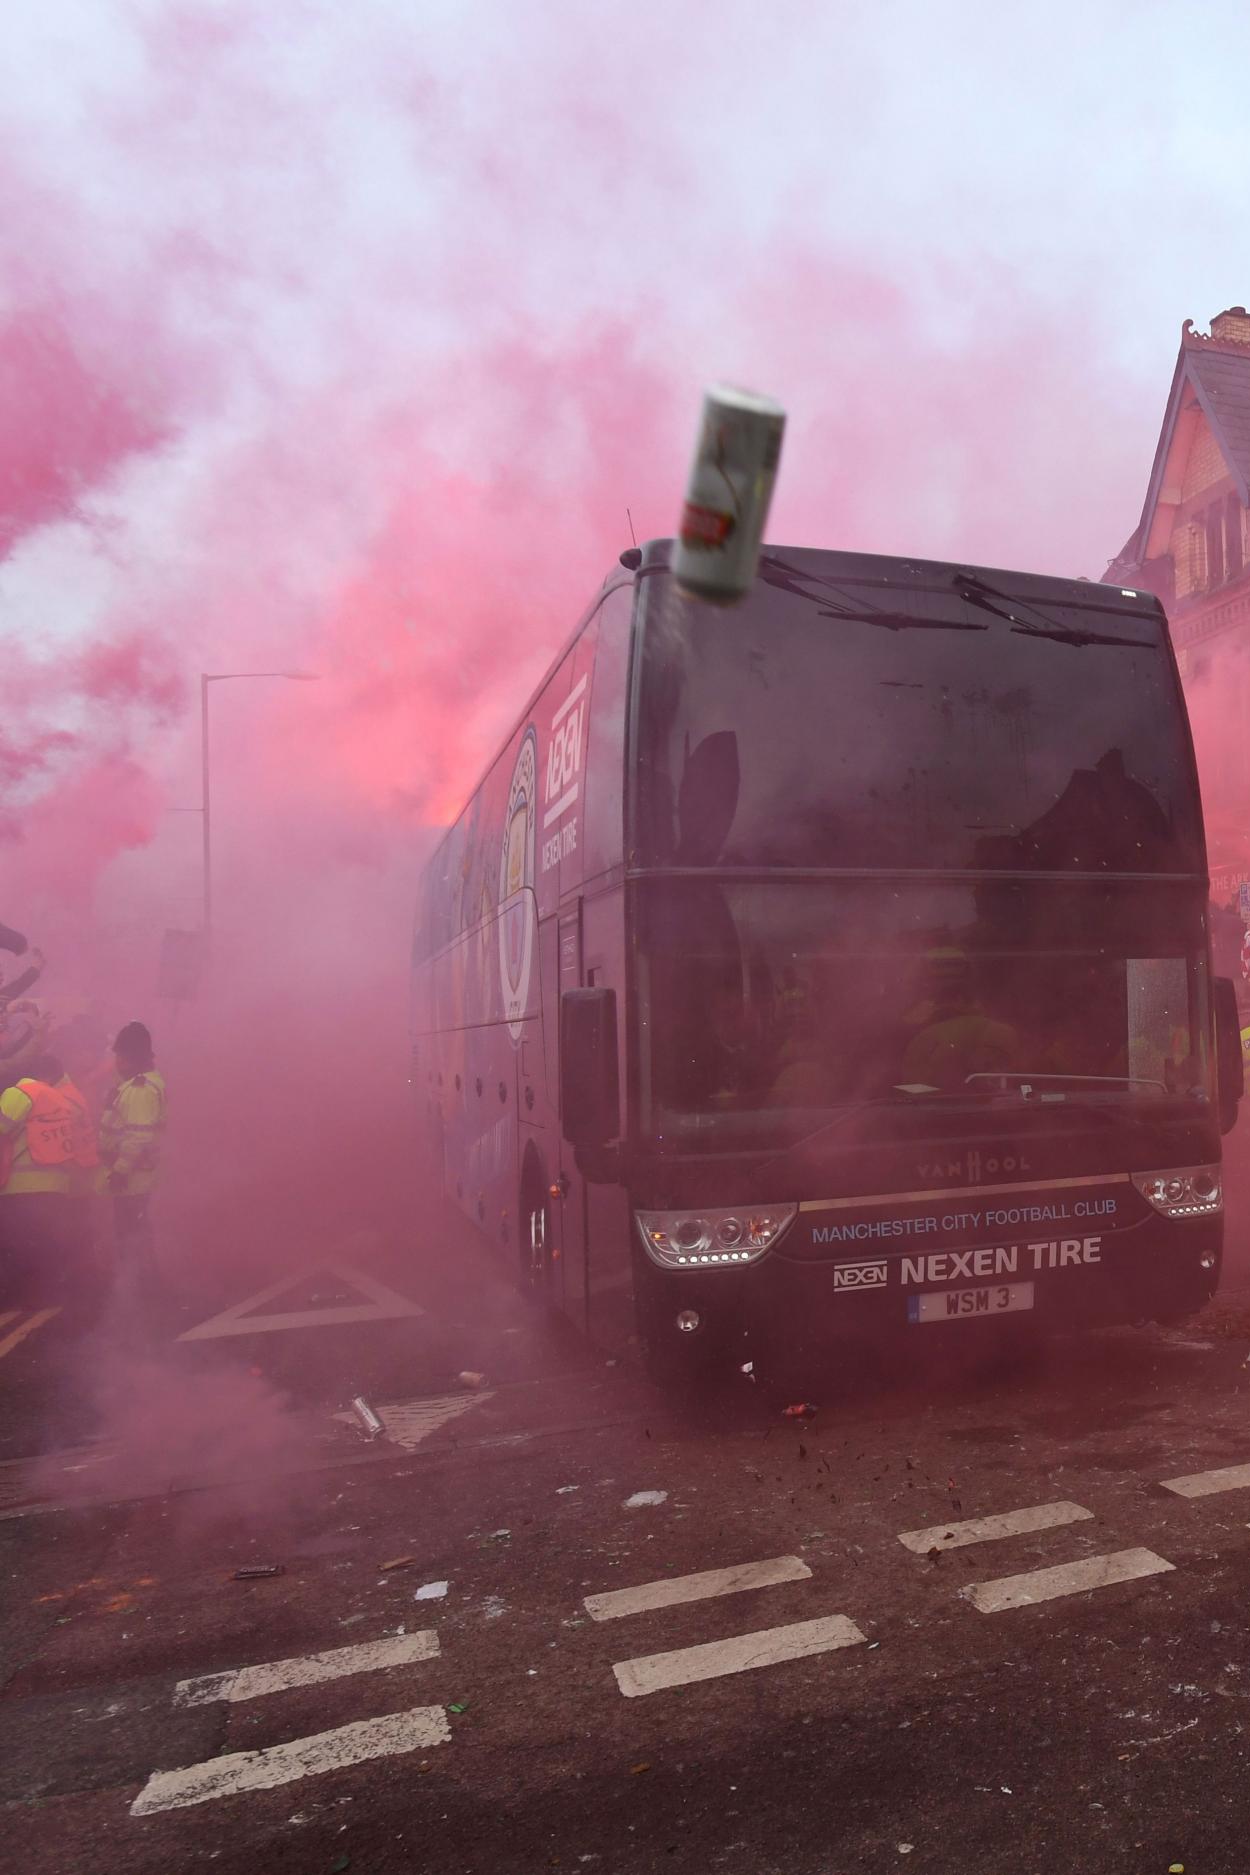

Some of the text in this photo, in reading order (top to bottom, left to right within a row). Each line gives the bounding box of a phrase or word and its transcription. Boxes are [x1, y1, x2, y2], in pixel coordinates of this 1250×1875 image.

[544, 700, 585, 804] NEXEN
[542, 815, 577, 874] NEXEN TIRE
[1210, 875, 1229, 891] THE
[812, 1199, 1117, 1244] MANCHESTER CITY FOOTBALL CLUB
[833, 1236, 1101, 1287] NEXEN NEXEN TIRE
[946, 1287, 1011, 1315] WSM 3
